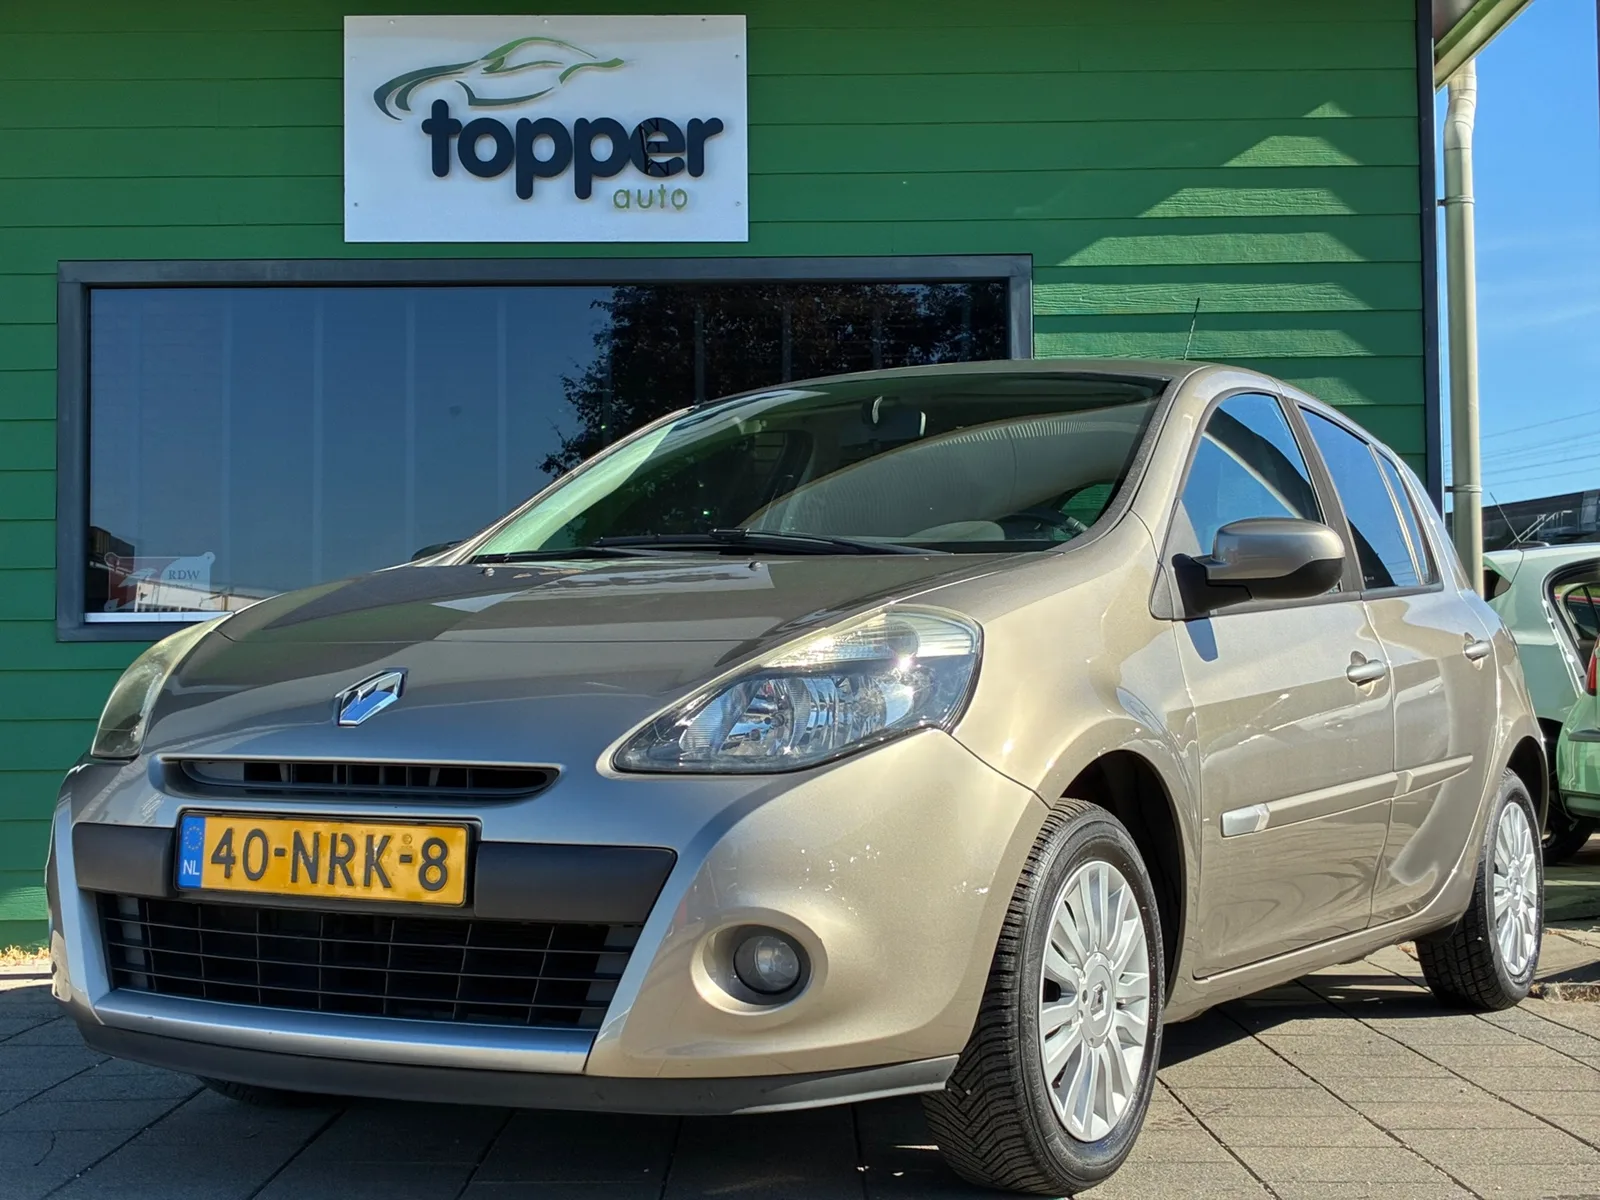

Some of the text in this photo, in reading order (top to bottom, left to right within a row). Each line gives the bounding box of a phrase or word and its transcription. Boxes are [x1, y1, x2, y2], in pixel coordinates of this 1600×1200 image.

[421, 98, 724, 200] topper
[613, 184, 688, 211] auto
[168, 569, 200, 580] RDW
[182, 859, 201, 876] NL
[210, 827, 449, 892] 40-NRK-8
